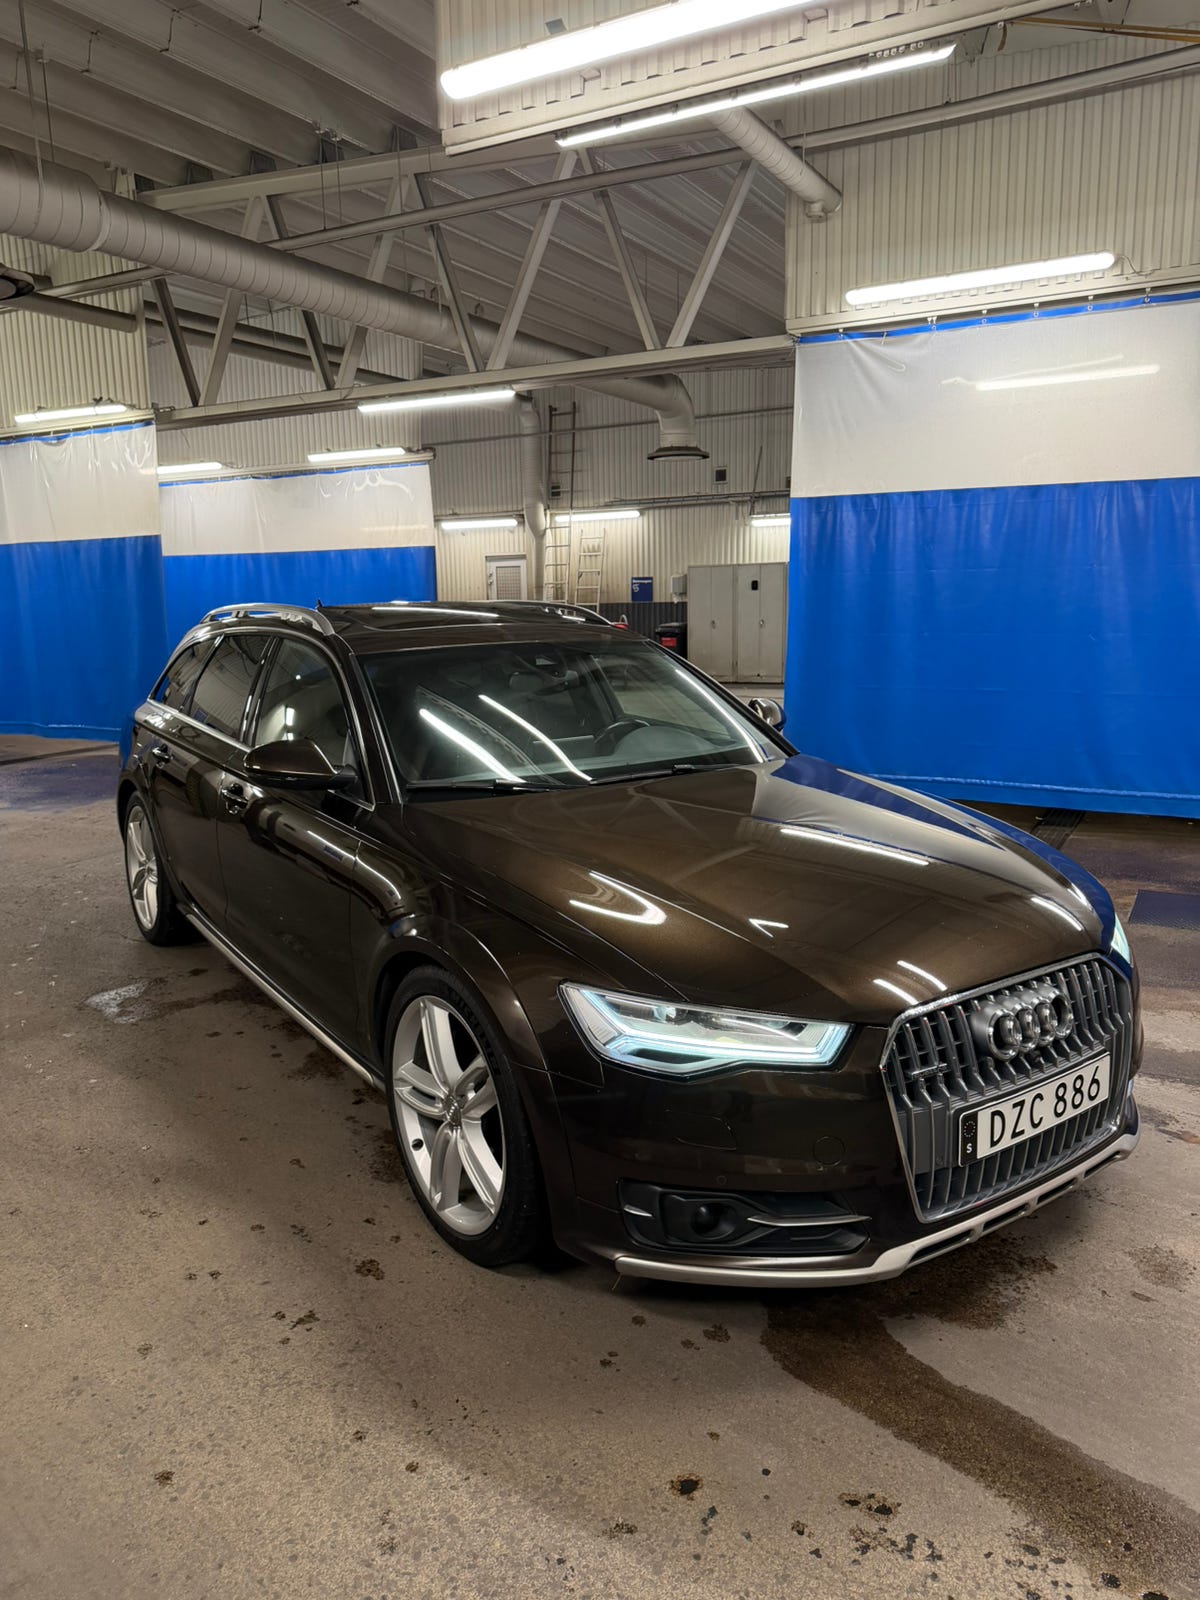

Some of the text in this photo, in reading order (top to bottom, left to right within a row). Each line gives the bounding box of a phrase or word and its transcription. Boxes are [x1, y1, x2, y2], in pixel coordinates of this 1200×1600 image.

[990, 1065, 1100, 1148] DZC 886
[966, 1143, 973, 1154] S
